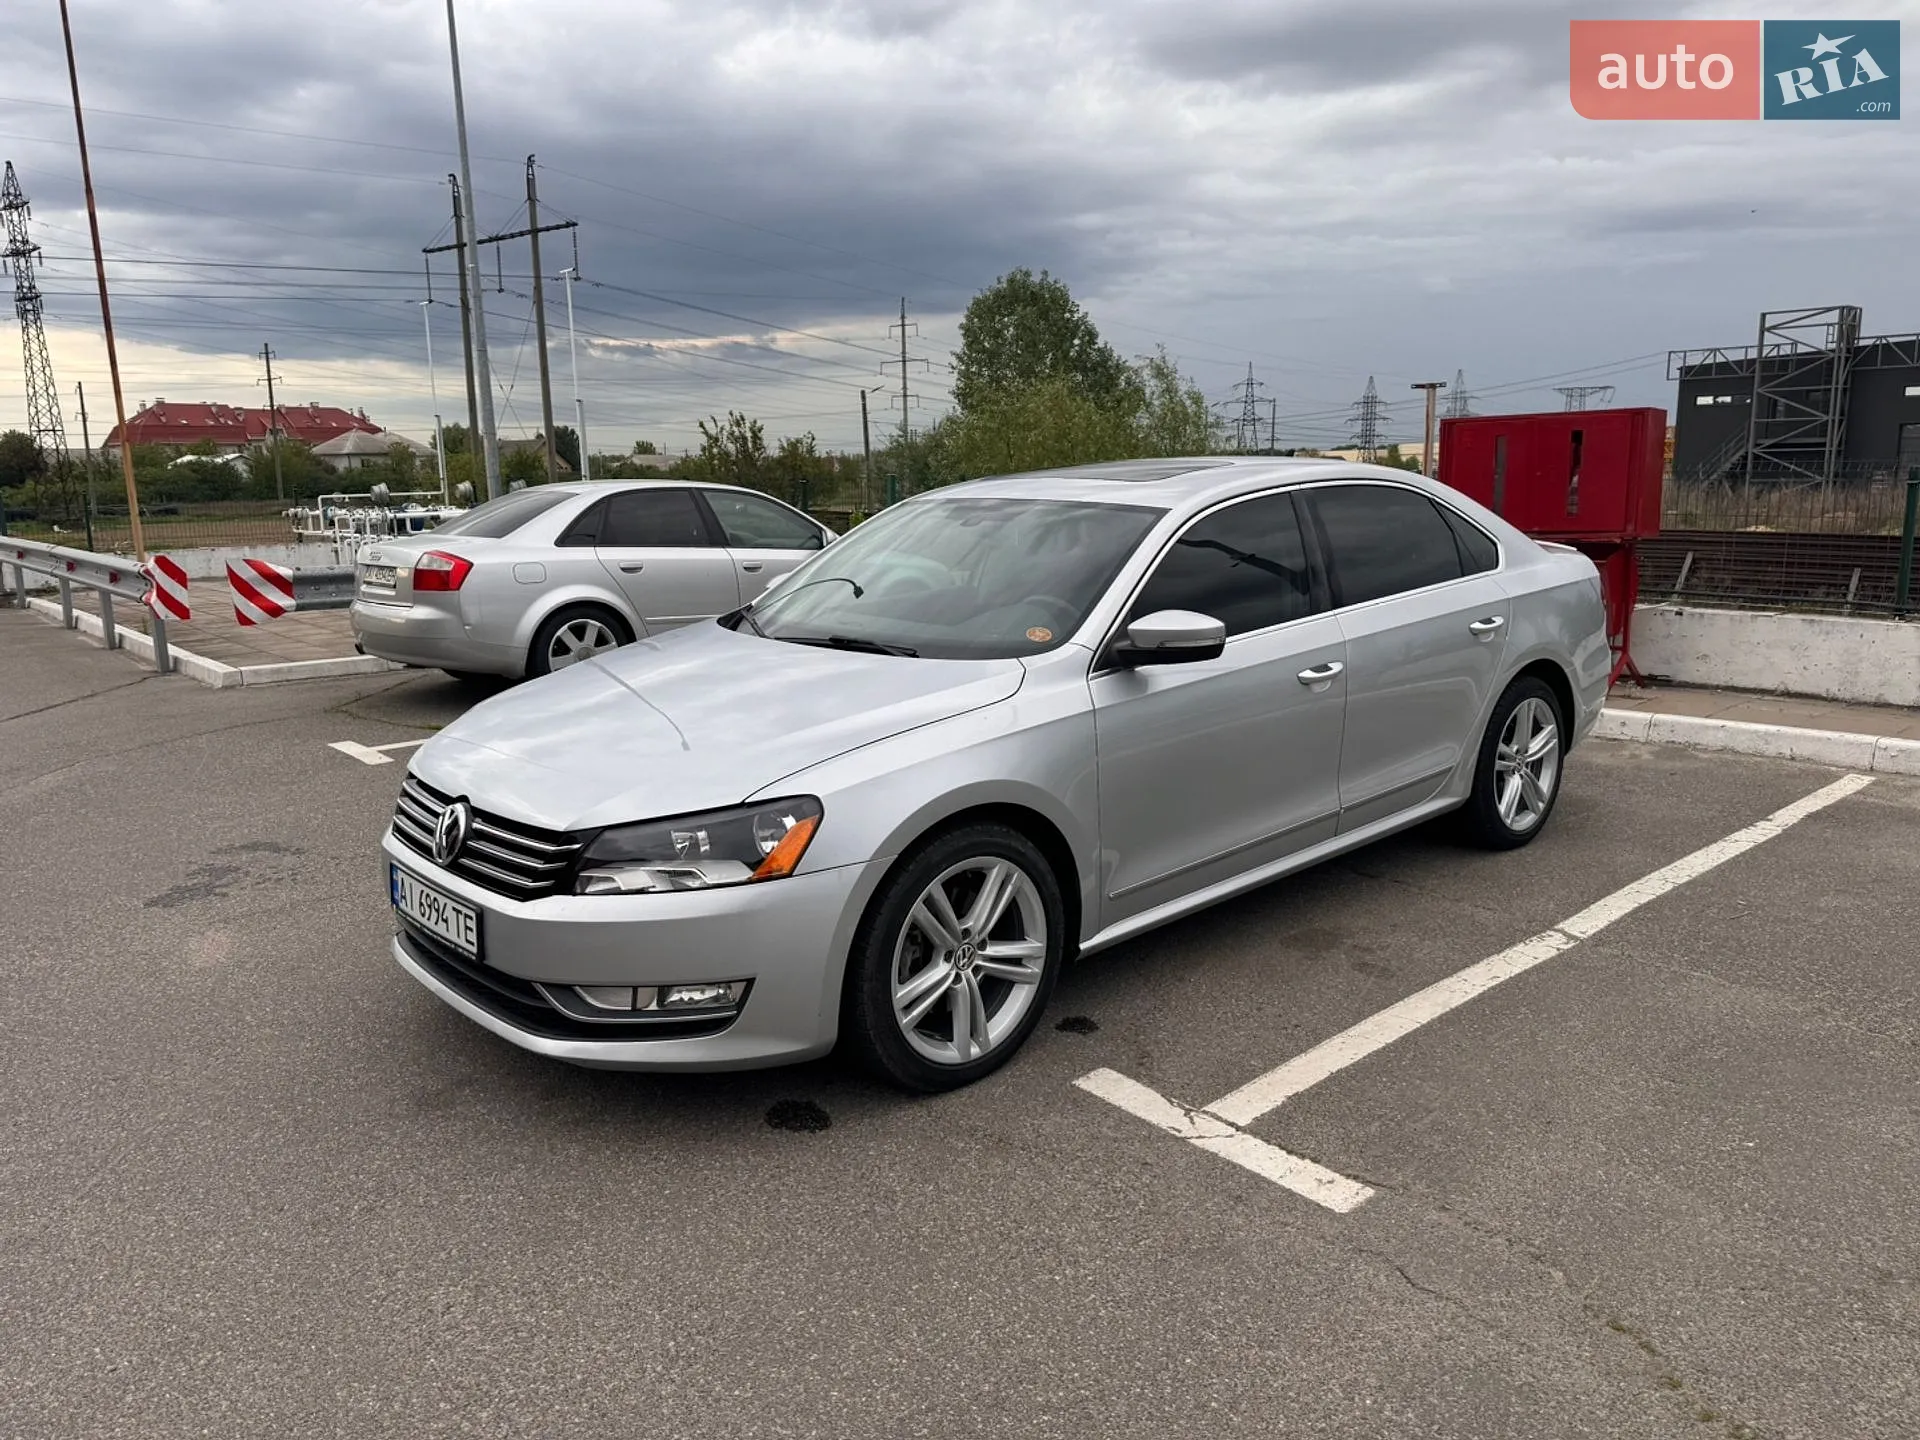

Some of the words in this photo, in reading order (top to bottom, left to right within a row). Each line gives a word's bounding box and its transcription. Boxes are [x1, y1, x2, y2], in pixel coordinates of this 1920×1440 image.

[400, 877, 414, 911] AI
[419, 889, 450, 933] 6994
[452, 906, 475, 947] TE
